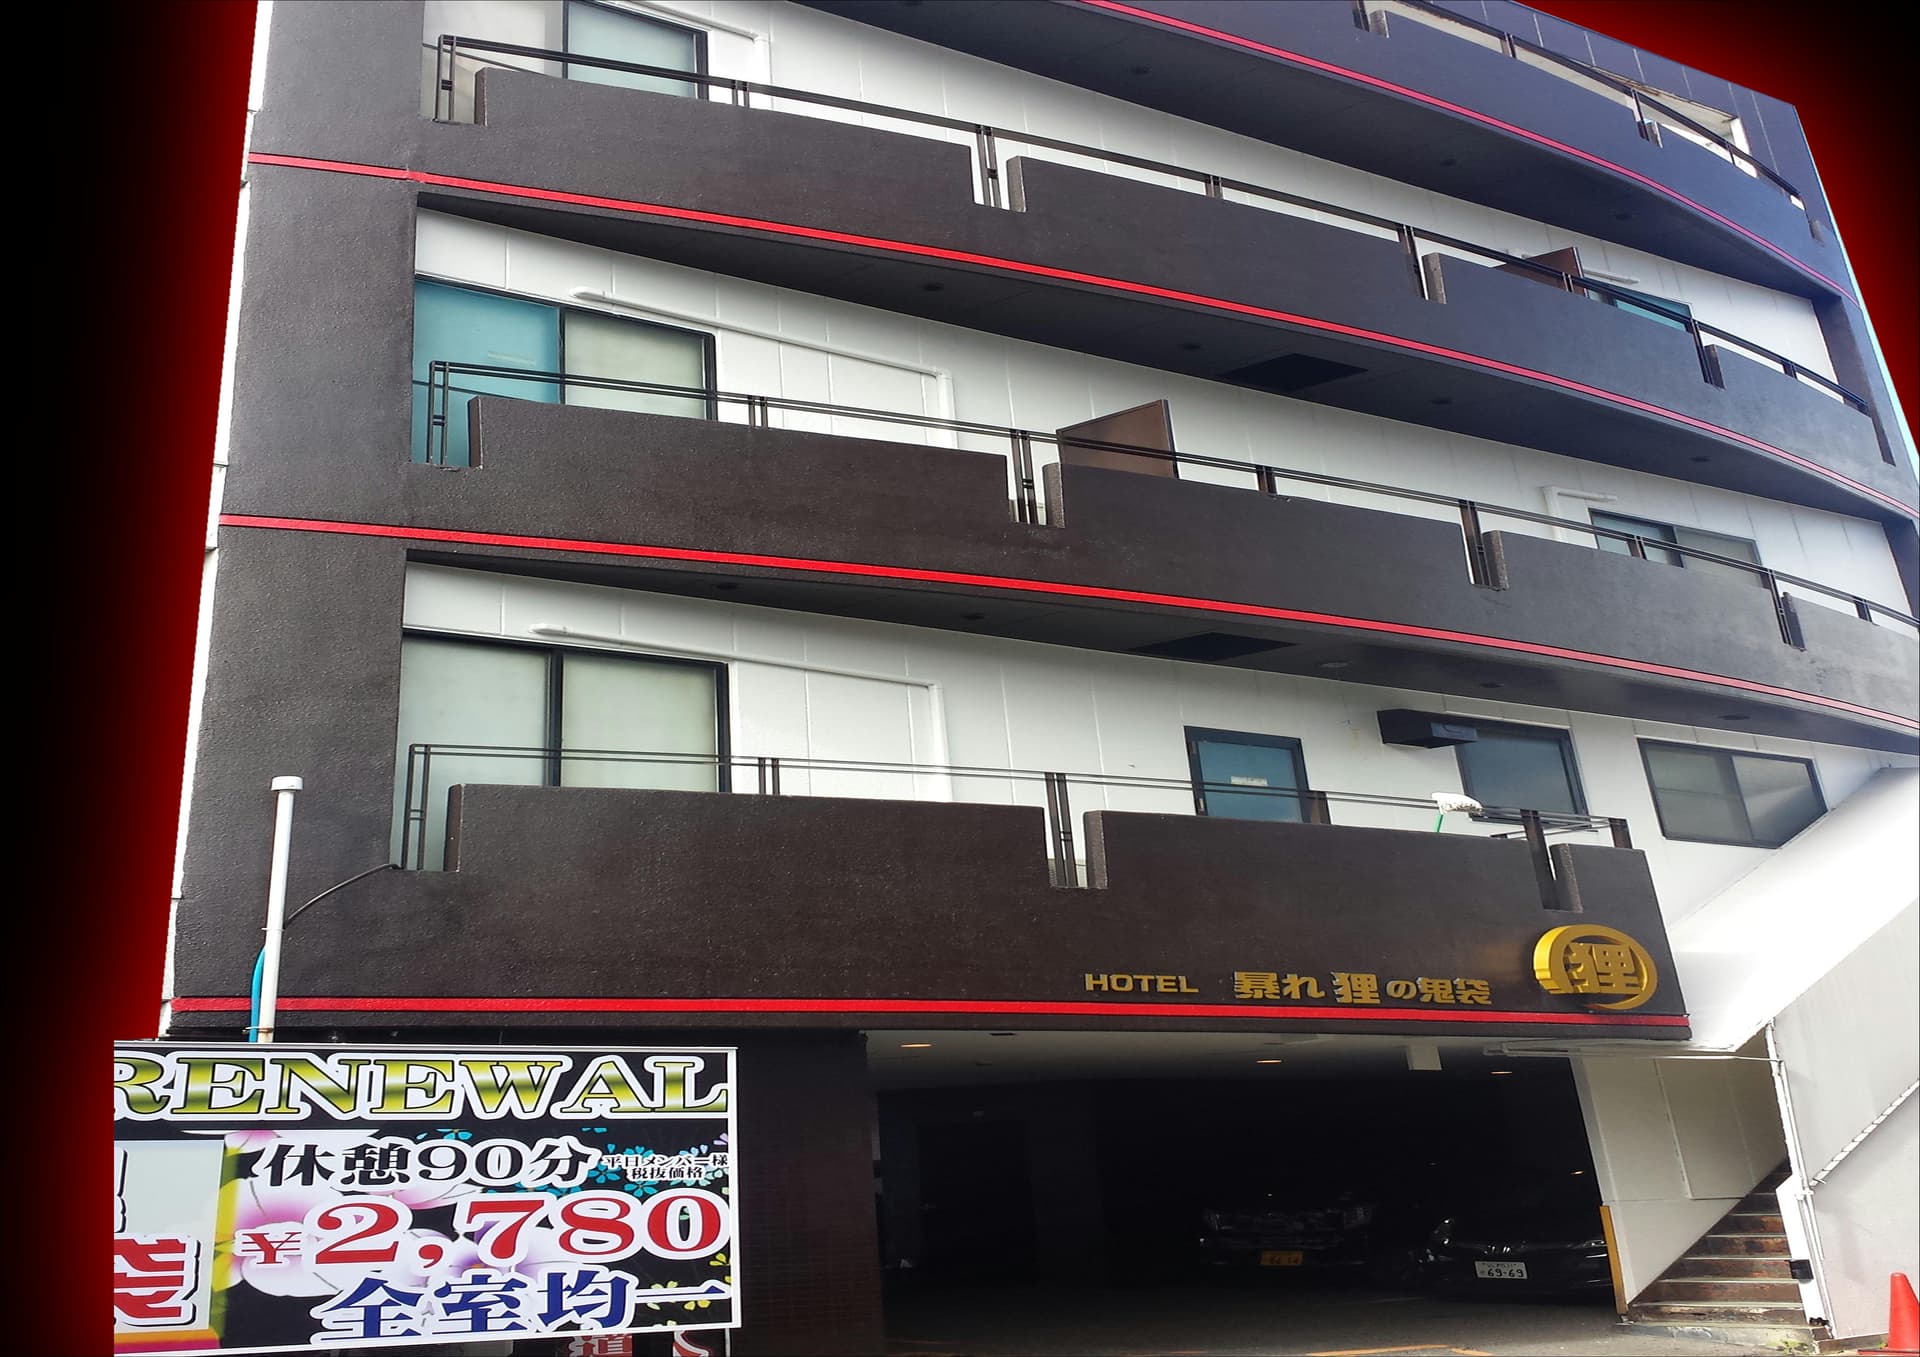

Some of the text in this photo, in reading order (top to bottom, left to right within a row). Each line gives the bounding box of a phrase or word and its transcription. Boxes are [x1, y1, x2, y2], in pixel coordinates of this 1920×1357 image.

[1085, 973, 1199, 993] HOTEL
[114, 1055, 728, 1116] RENEWAL
[264, 1140, 591, 1187] 休憩90分
[603, 1154, 728, 1169] 平日メンバー様
[631, 1167, 704, 1179] 税抜価格
[241, 1195, 722, 1269] ¥2,780
[1487, 1268, 1524, 1278] 69-69
[320, 1271, 729, 1340] 全室均一
